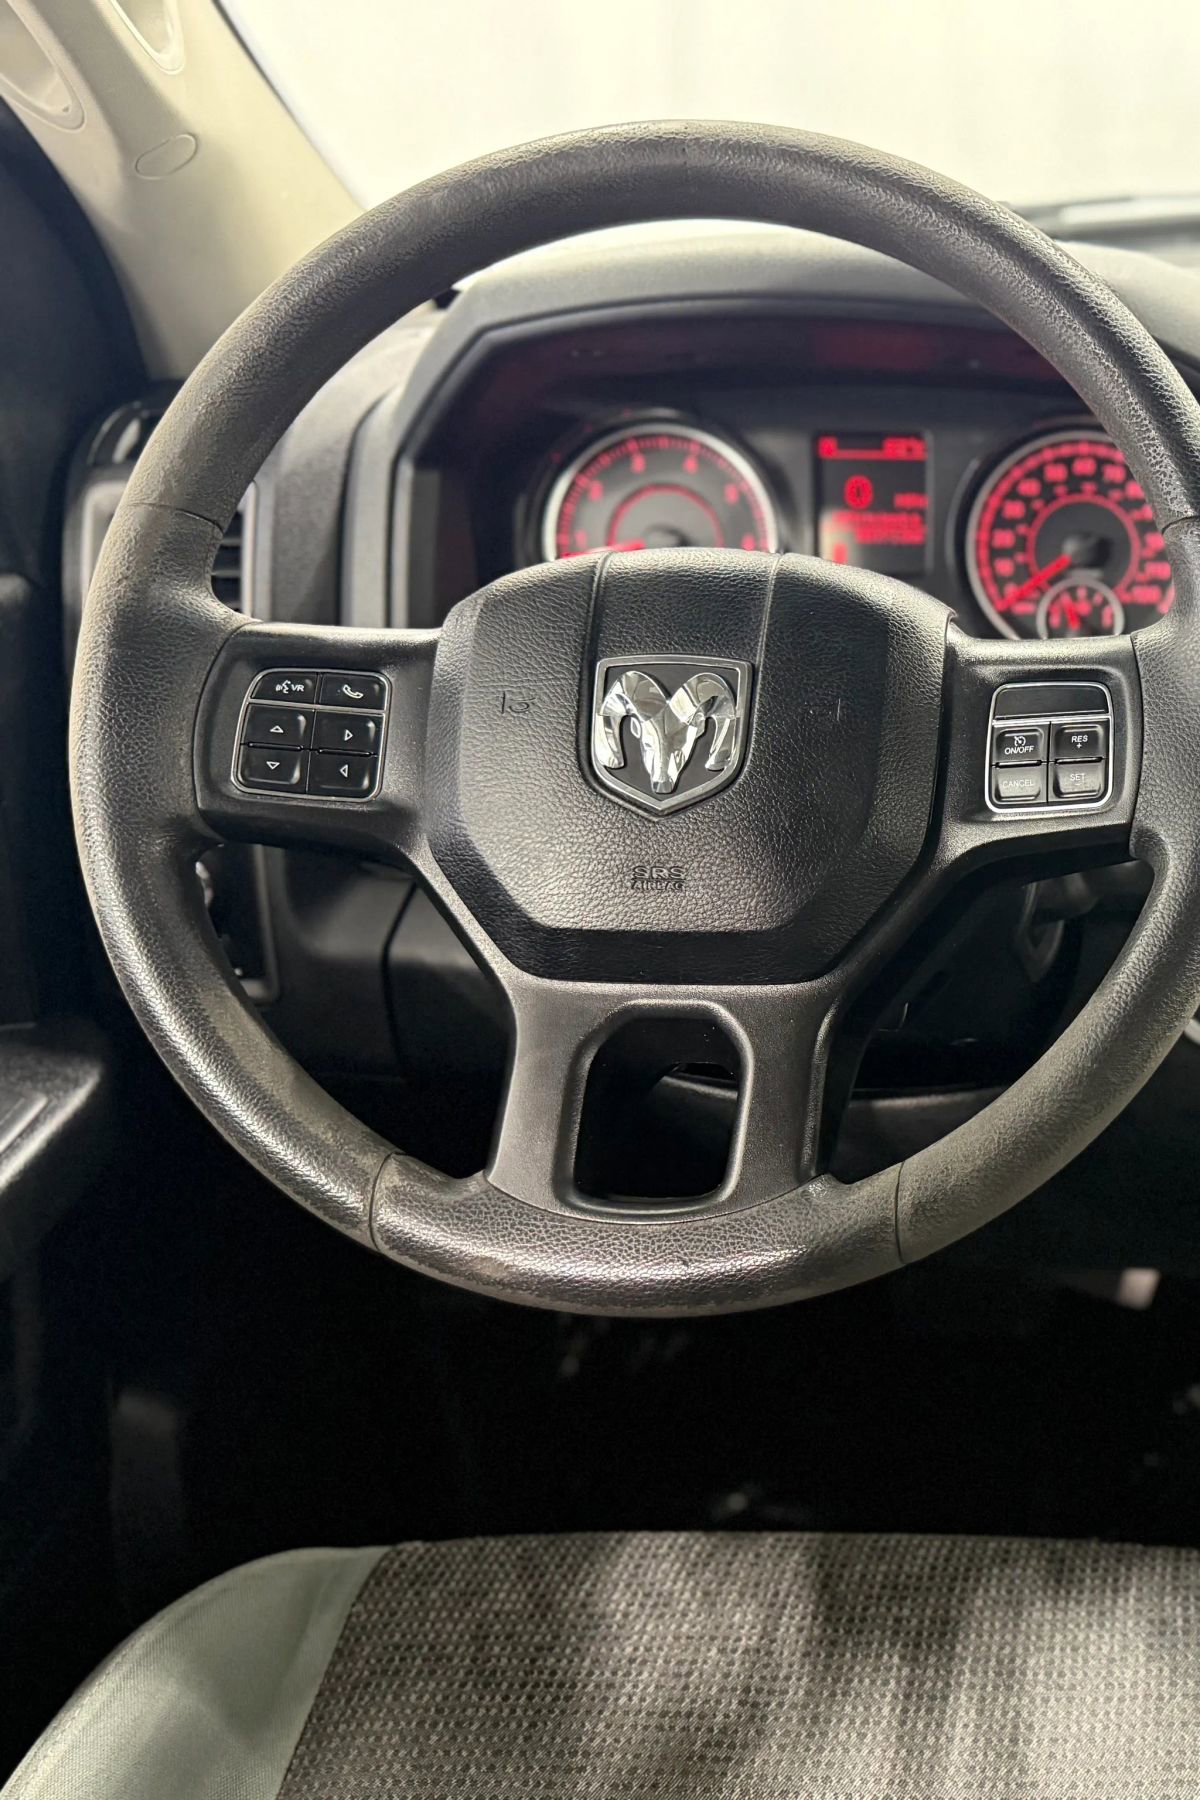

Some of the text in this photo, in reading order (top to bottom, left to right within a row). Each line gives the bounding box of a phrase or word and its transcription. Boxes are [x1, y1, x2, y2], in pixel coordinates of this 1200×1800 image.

[291, 684, 305, 692] VR
[1071, 735, 1088, 743] RES
[1004, 745, 1035, 755] ON/OFF
[1070, 773, 1085, 782] SET
[1002, 780, 1034, 789] CANCEL
[632, 866, 686, 880] SRS
